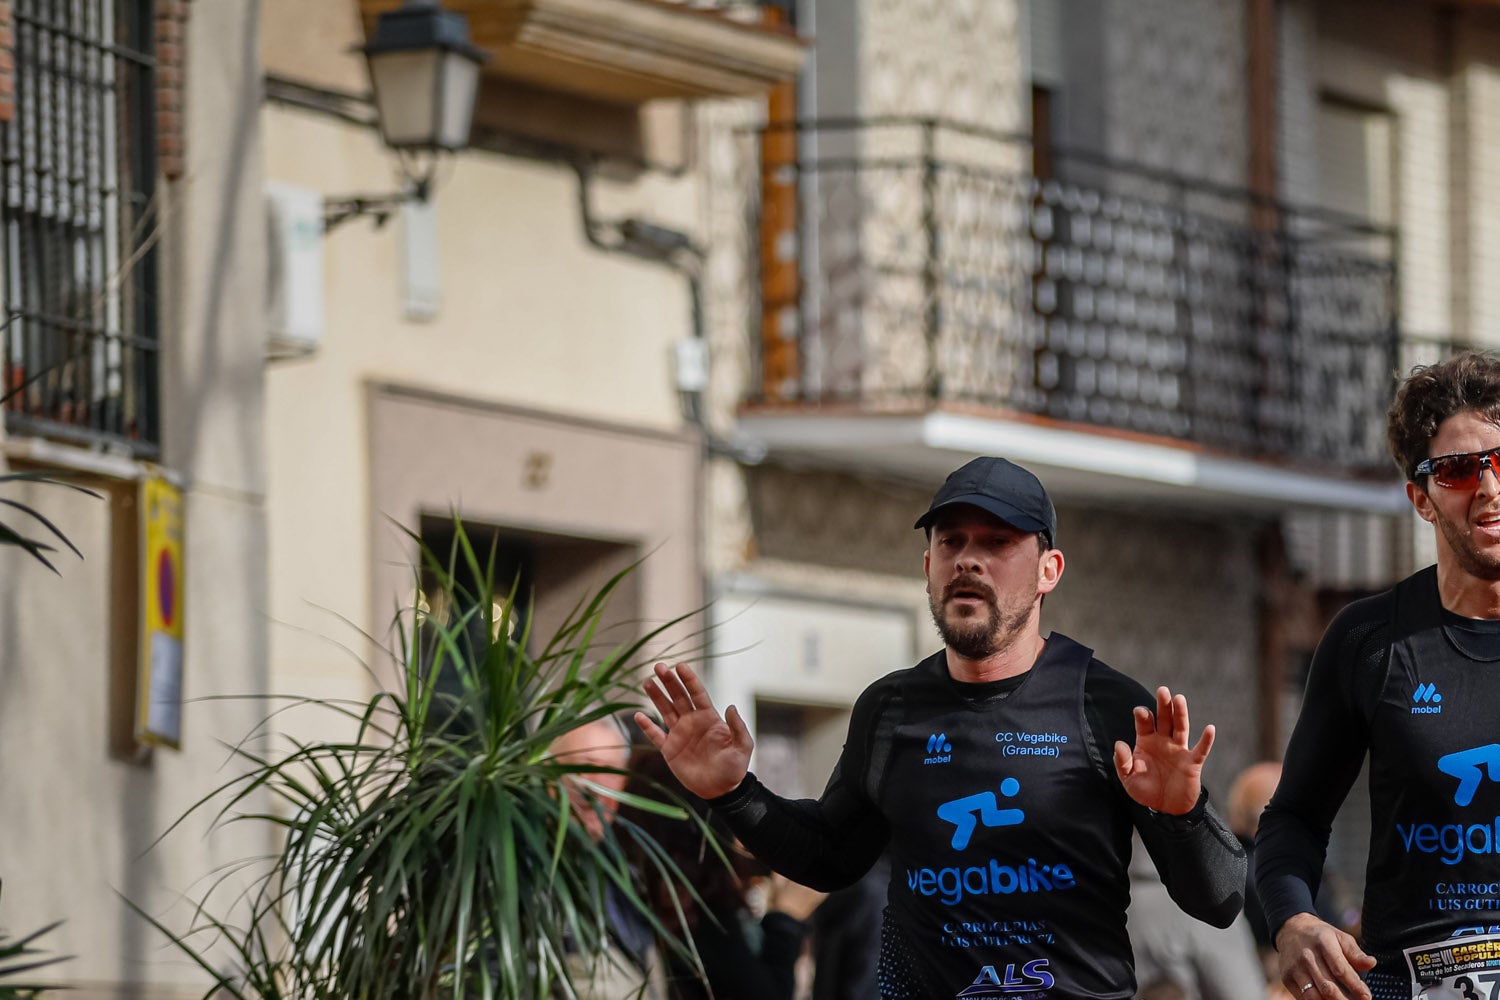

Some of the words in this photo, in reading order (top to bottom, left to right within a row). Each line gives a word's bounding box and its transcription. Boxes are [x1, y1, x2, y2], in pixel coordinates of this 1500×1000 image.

[1411, 705, 1442, 714] mobel
[995, 732, 1013, 742] CC
[1016, 732, 1068, 744] Vegabike
[1002, 745, 1060, 758] (Granada)
[923, 754, 952, 765] mobel
[906, 858, 1077, 906] vegabike
[1415, 953, 1431, 966] 26
[1453, 961, 1485, 971] Secaderos
[972, 958, 1055, 990] ALS
